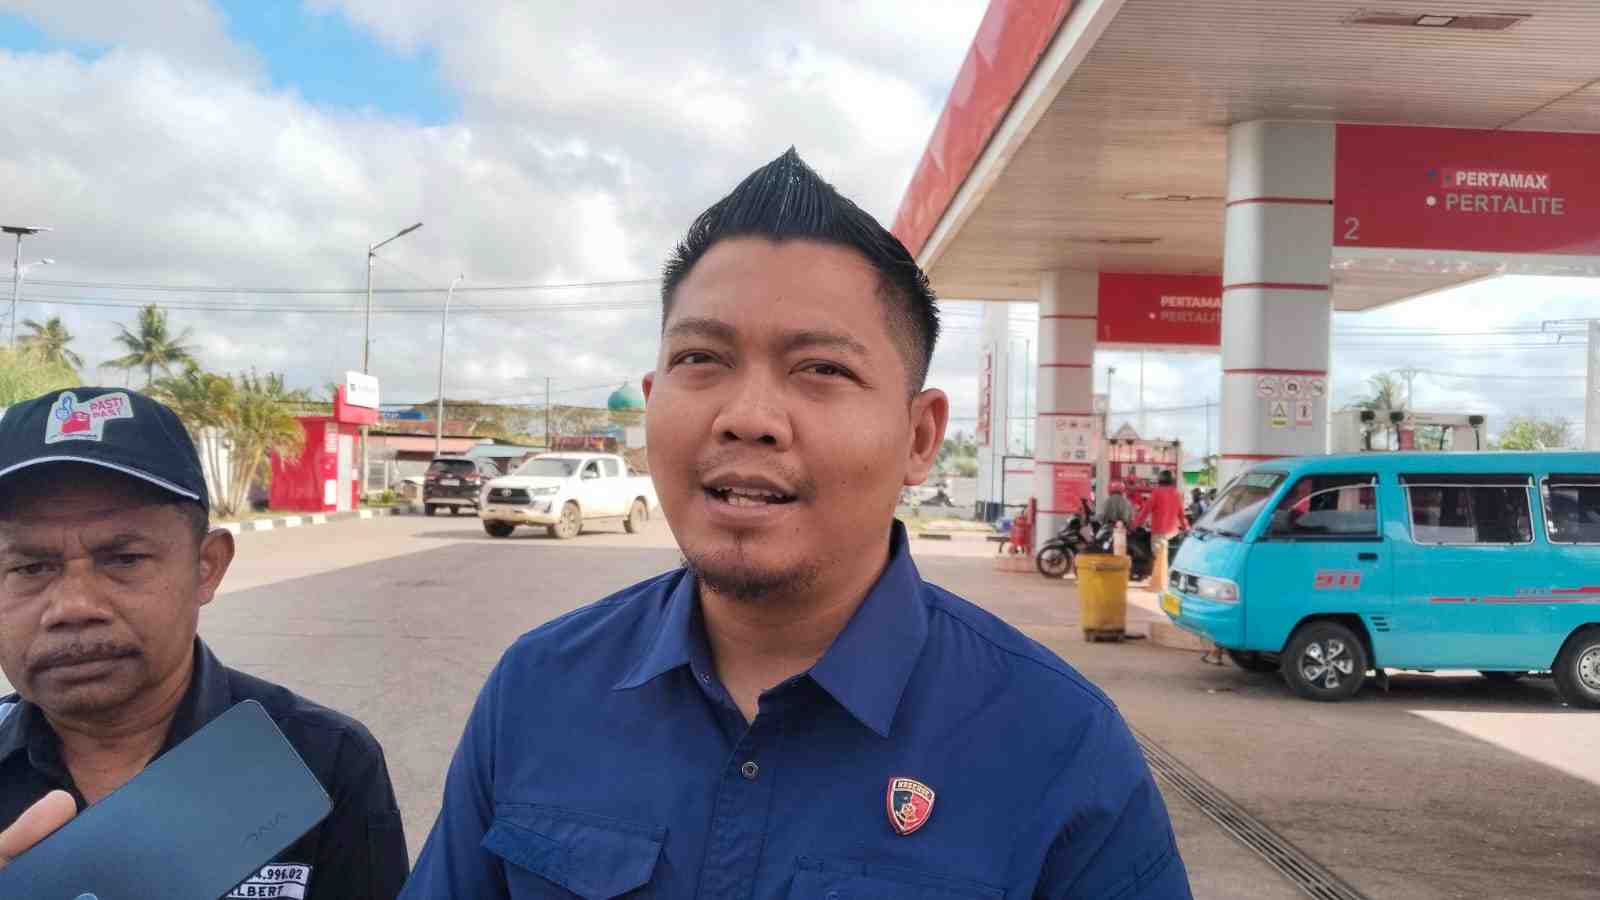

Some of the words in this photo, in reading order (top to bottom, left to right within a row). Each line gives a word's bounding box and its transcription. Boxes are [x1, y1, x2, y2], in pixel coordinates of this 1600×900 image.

[1455, 170, 1548, 190] PERTAMAX
[1445, 193, 1565, 216] PERTALITE
[1343, 216, 1360, 240] 2
[1160, 295, 1221, 308] PERTAMA
